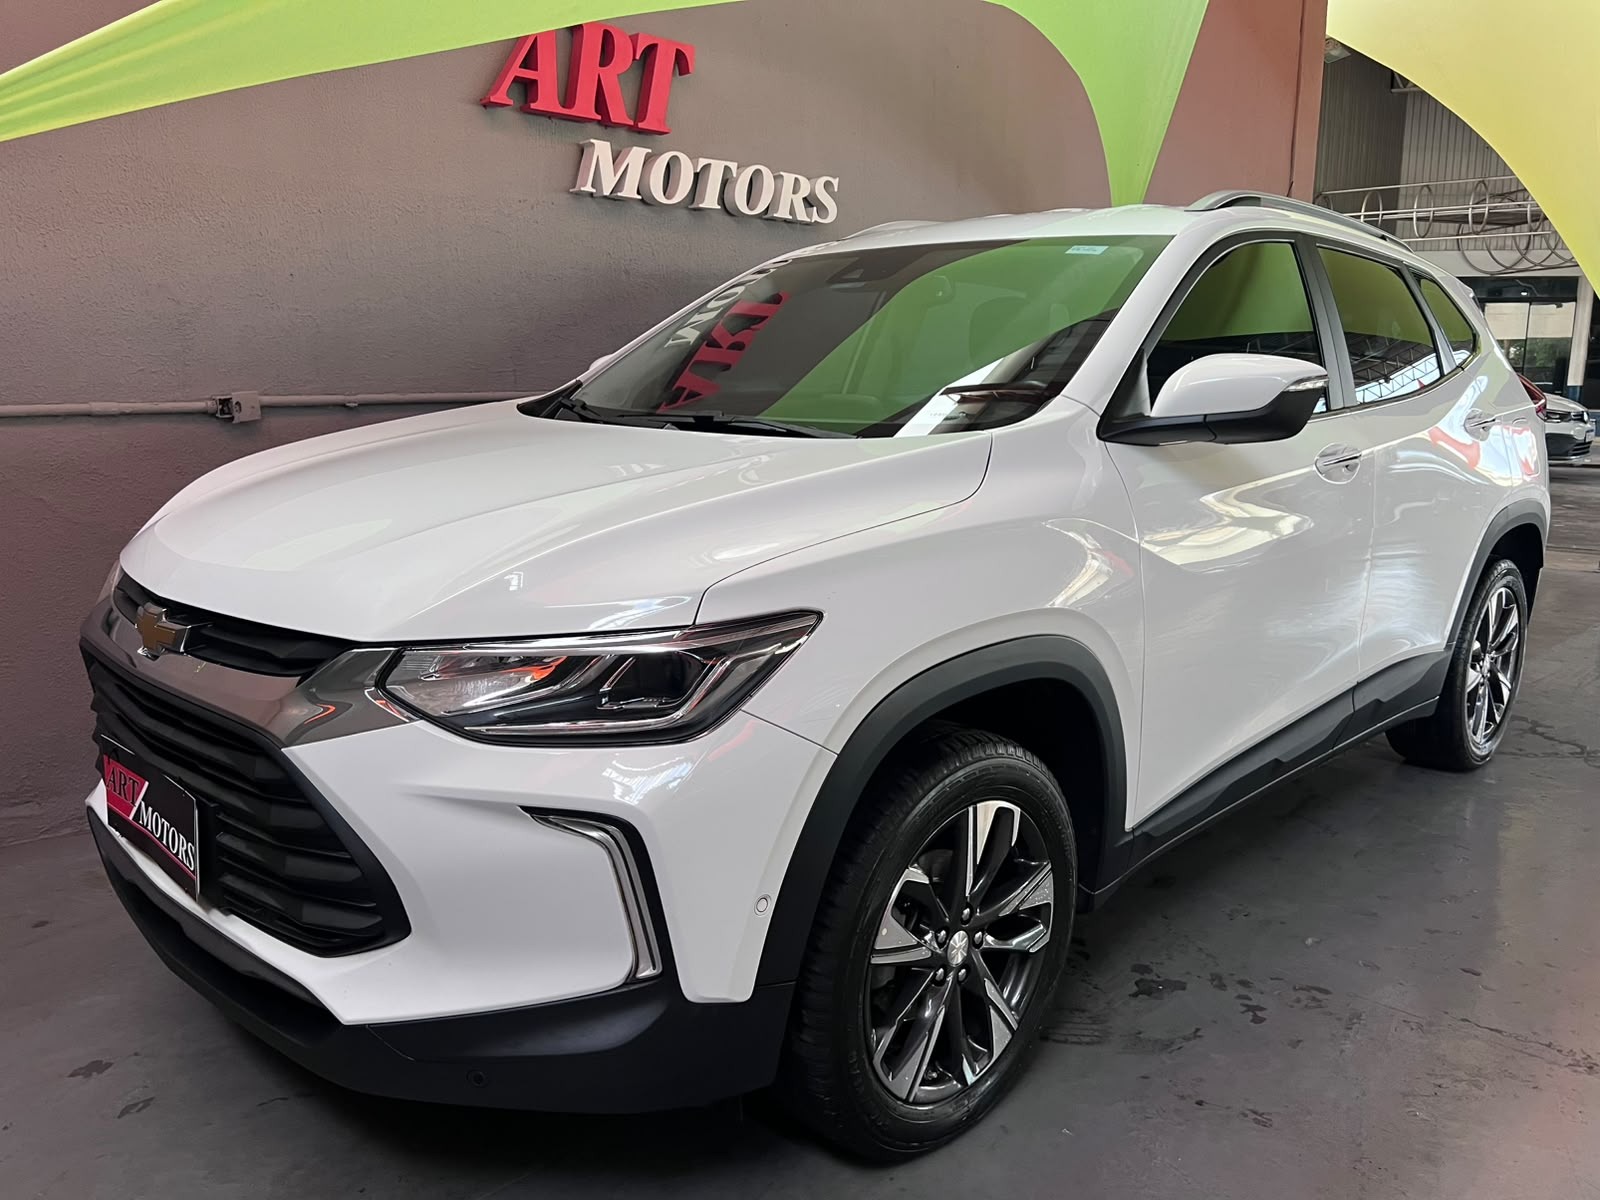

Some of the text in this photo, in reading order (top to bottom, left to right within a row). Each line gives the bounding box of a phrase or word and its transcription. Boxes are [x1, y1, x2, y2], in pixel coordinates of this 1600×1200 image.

[480, 22, 696, 135] ART
[570, 138, 839, 224] MOTORS
[106, 766, 140, 808] ART
[139, 800, 195, 870] MOTORS
